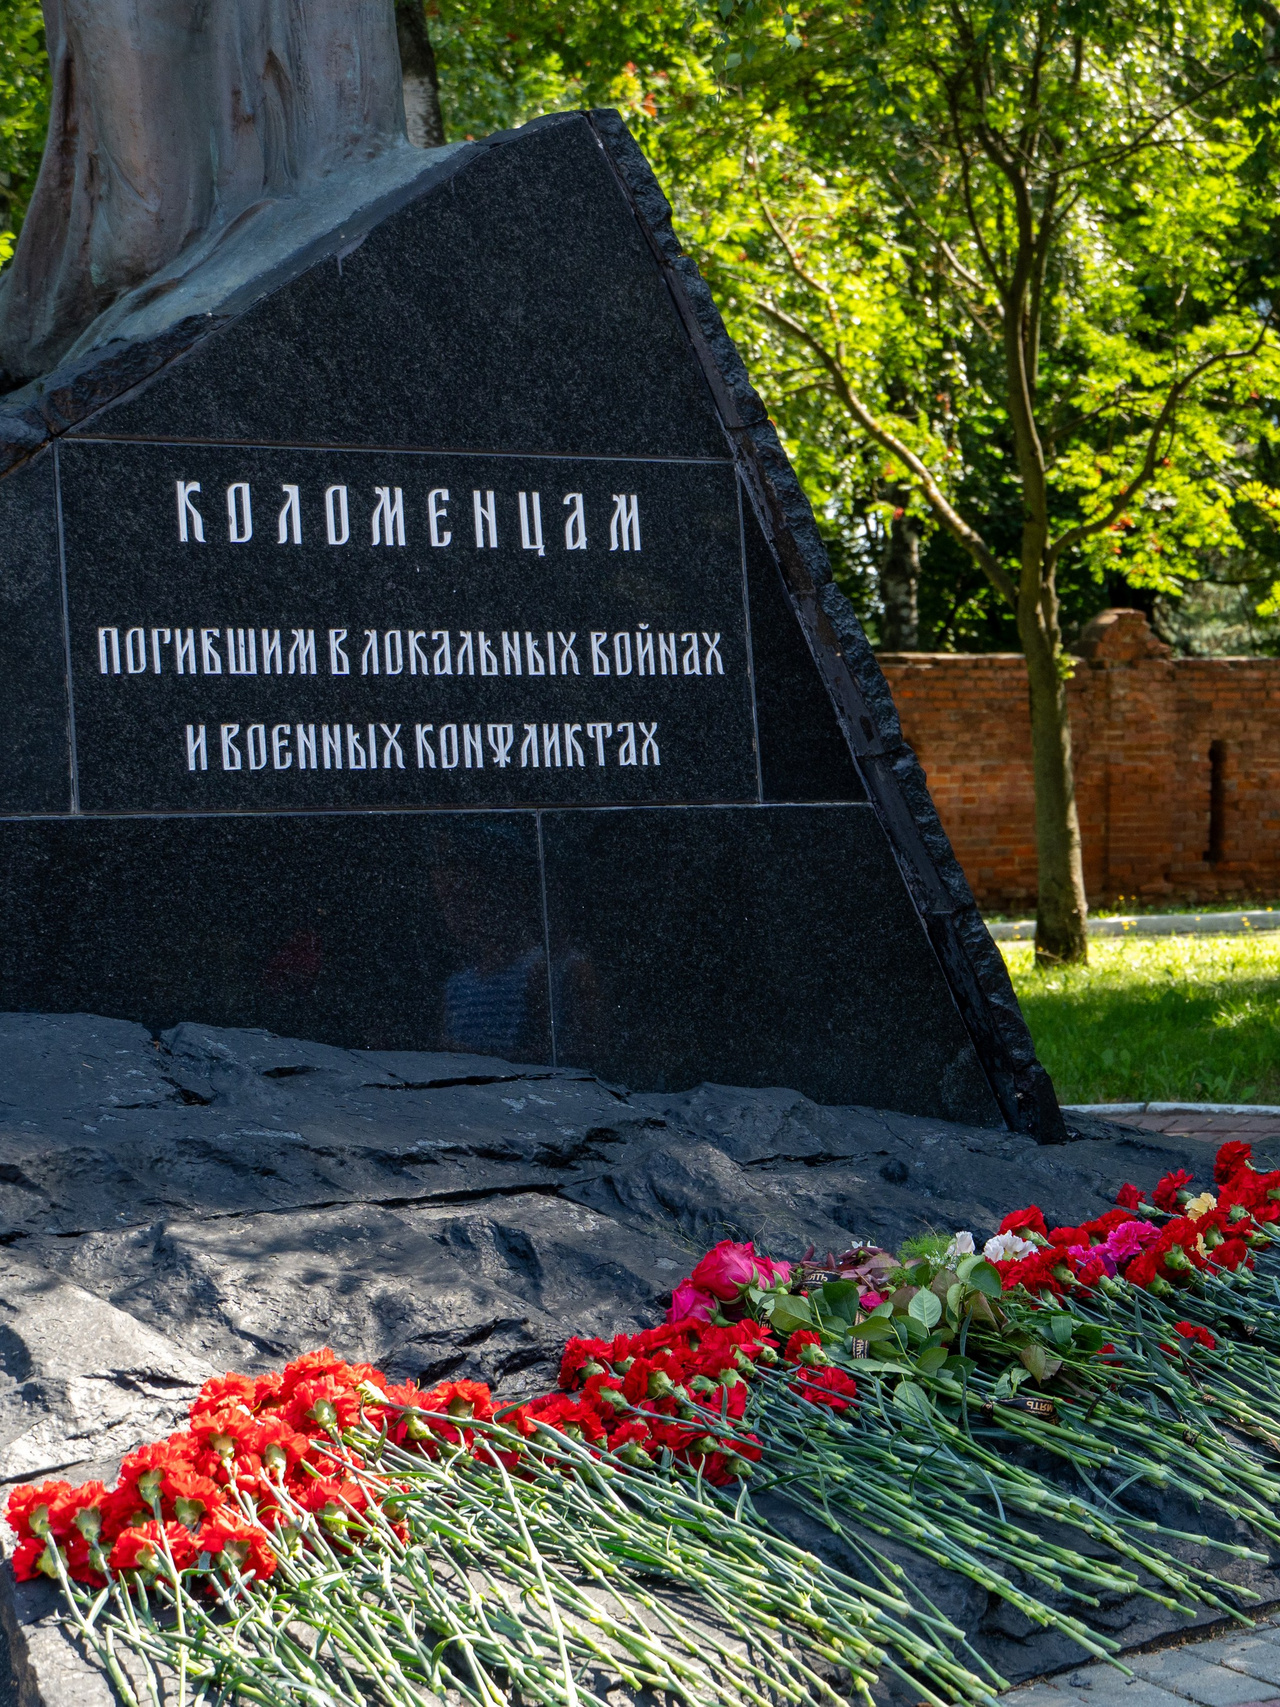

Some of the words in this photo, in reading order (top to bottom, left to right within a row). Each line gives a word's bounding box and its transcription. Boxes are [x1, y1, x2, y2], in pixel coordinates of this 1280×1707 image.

[176, 480, 641, 556] КОЛОМЕНЦАМ
[98, 626, 316, 675] ПОГИБШИМ
[330, 628, 350, 675] В
[361, 631, 579, 676] ЛОКАЛЬНЫХ
[591, 623, 724, 676] ВОЙНАХ
[187, 724, 207, 771] И
[222, 723, 406, 771] ВОЕННЫХ
[416, 722, 661, 769] КОНФЛИКТАХ
